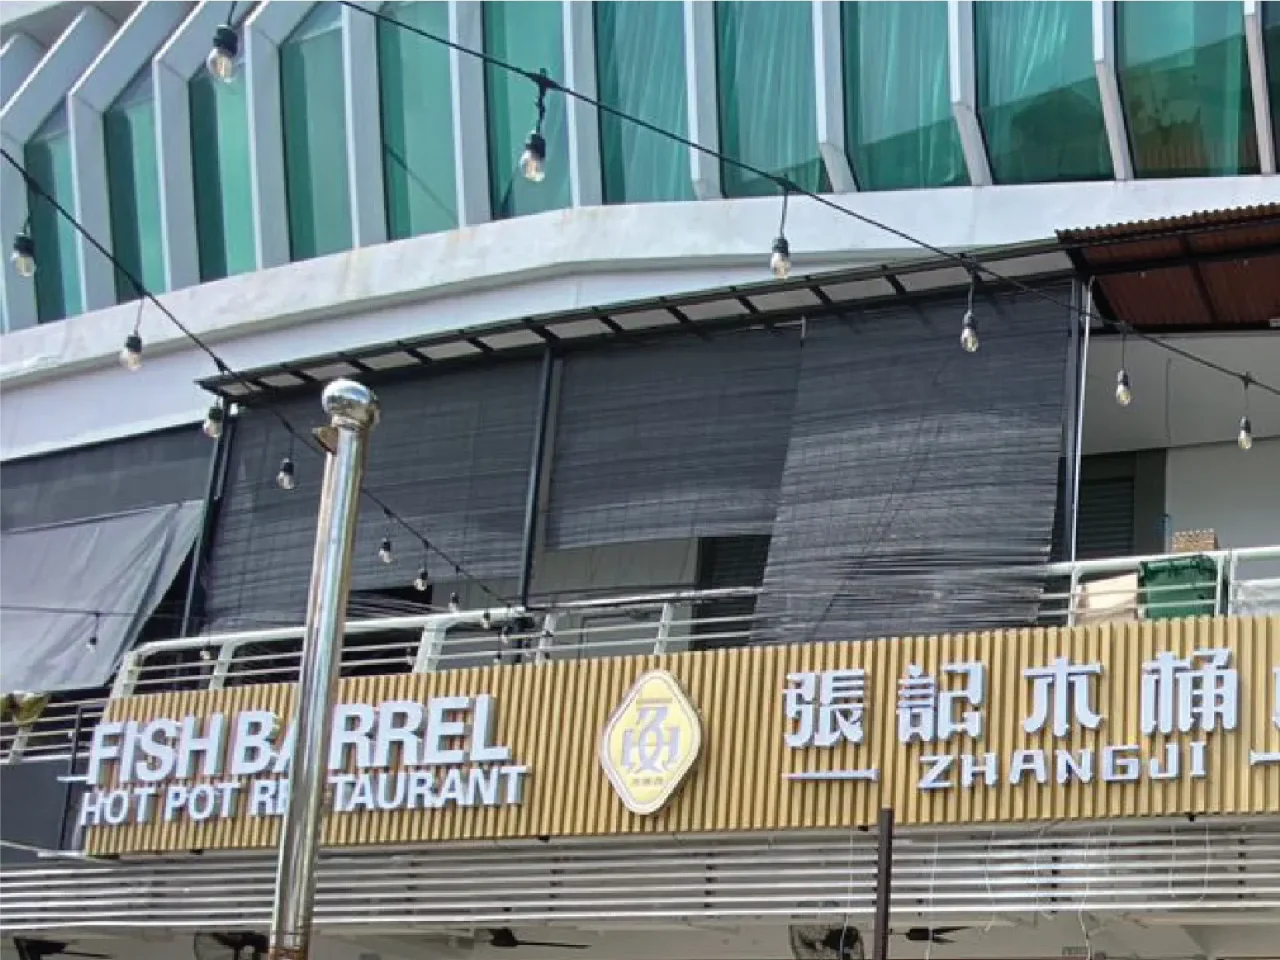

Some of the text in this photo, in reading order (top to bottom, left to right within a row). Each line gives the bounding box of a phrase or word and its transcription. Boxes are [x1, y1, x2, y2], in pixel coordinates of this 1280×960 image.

[87, 712, 224, 785] FISH
[918, 741, 1209, 790] ZHANGJI
[80, 764, 528, 826] HOT POT RETAURANT
